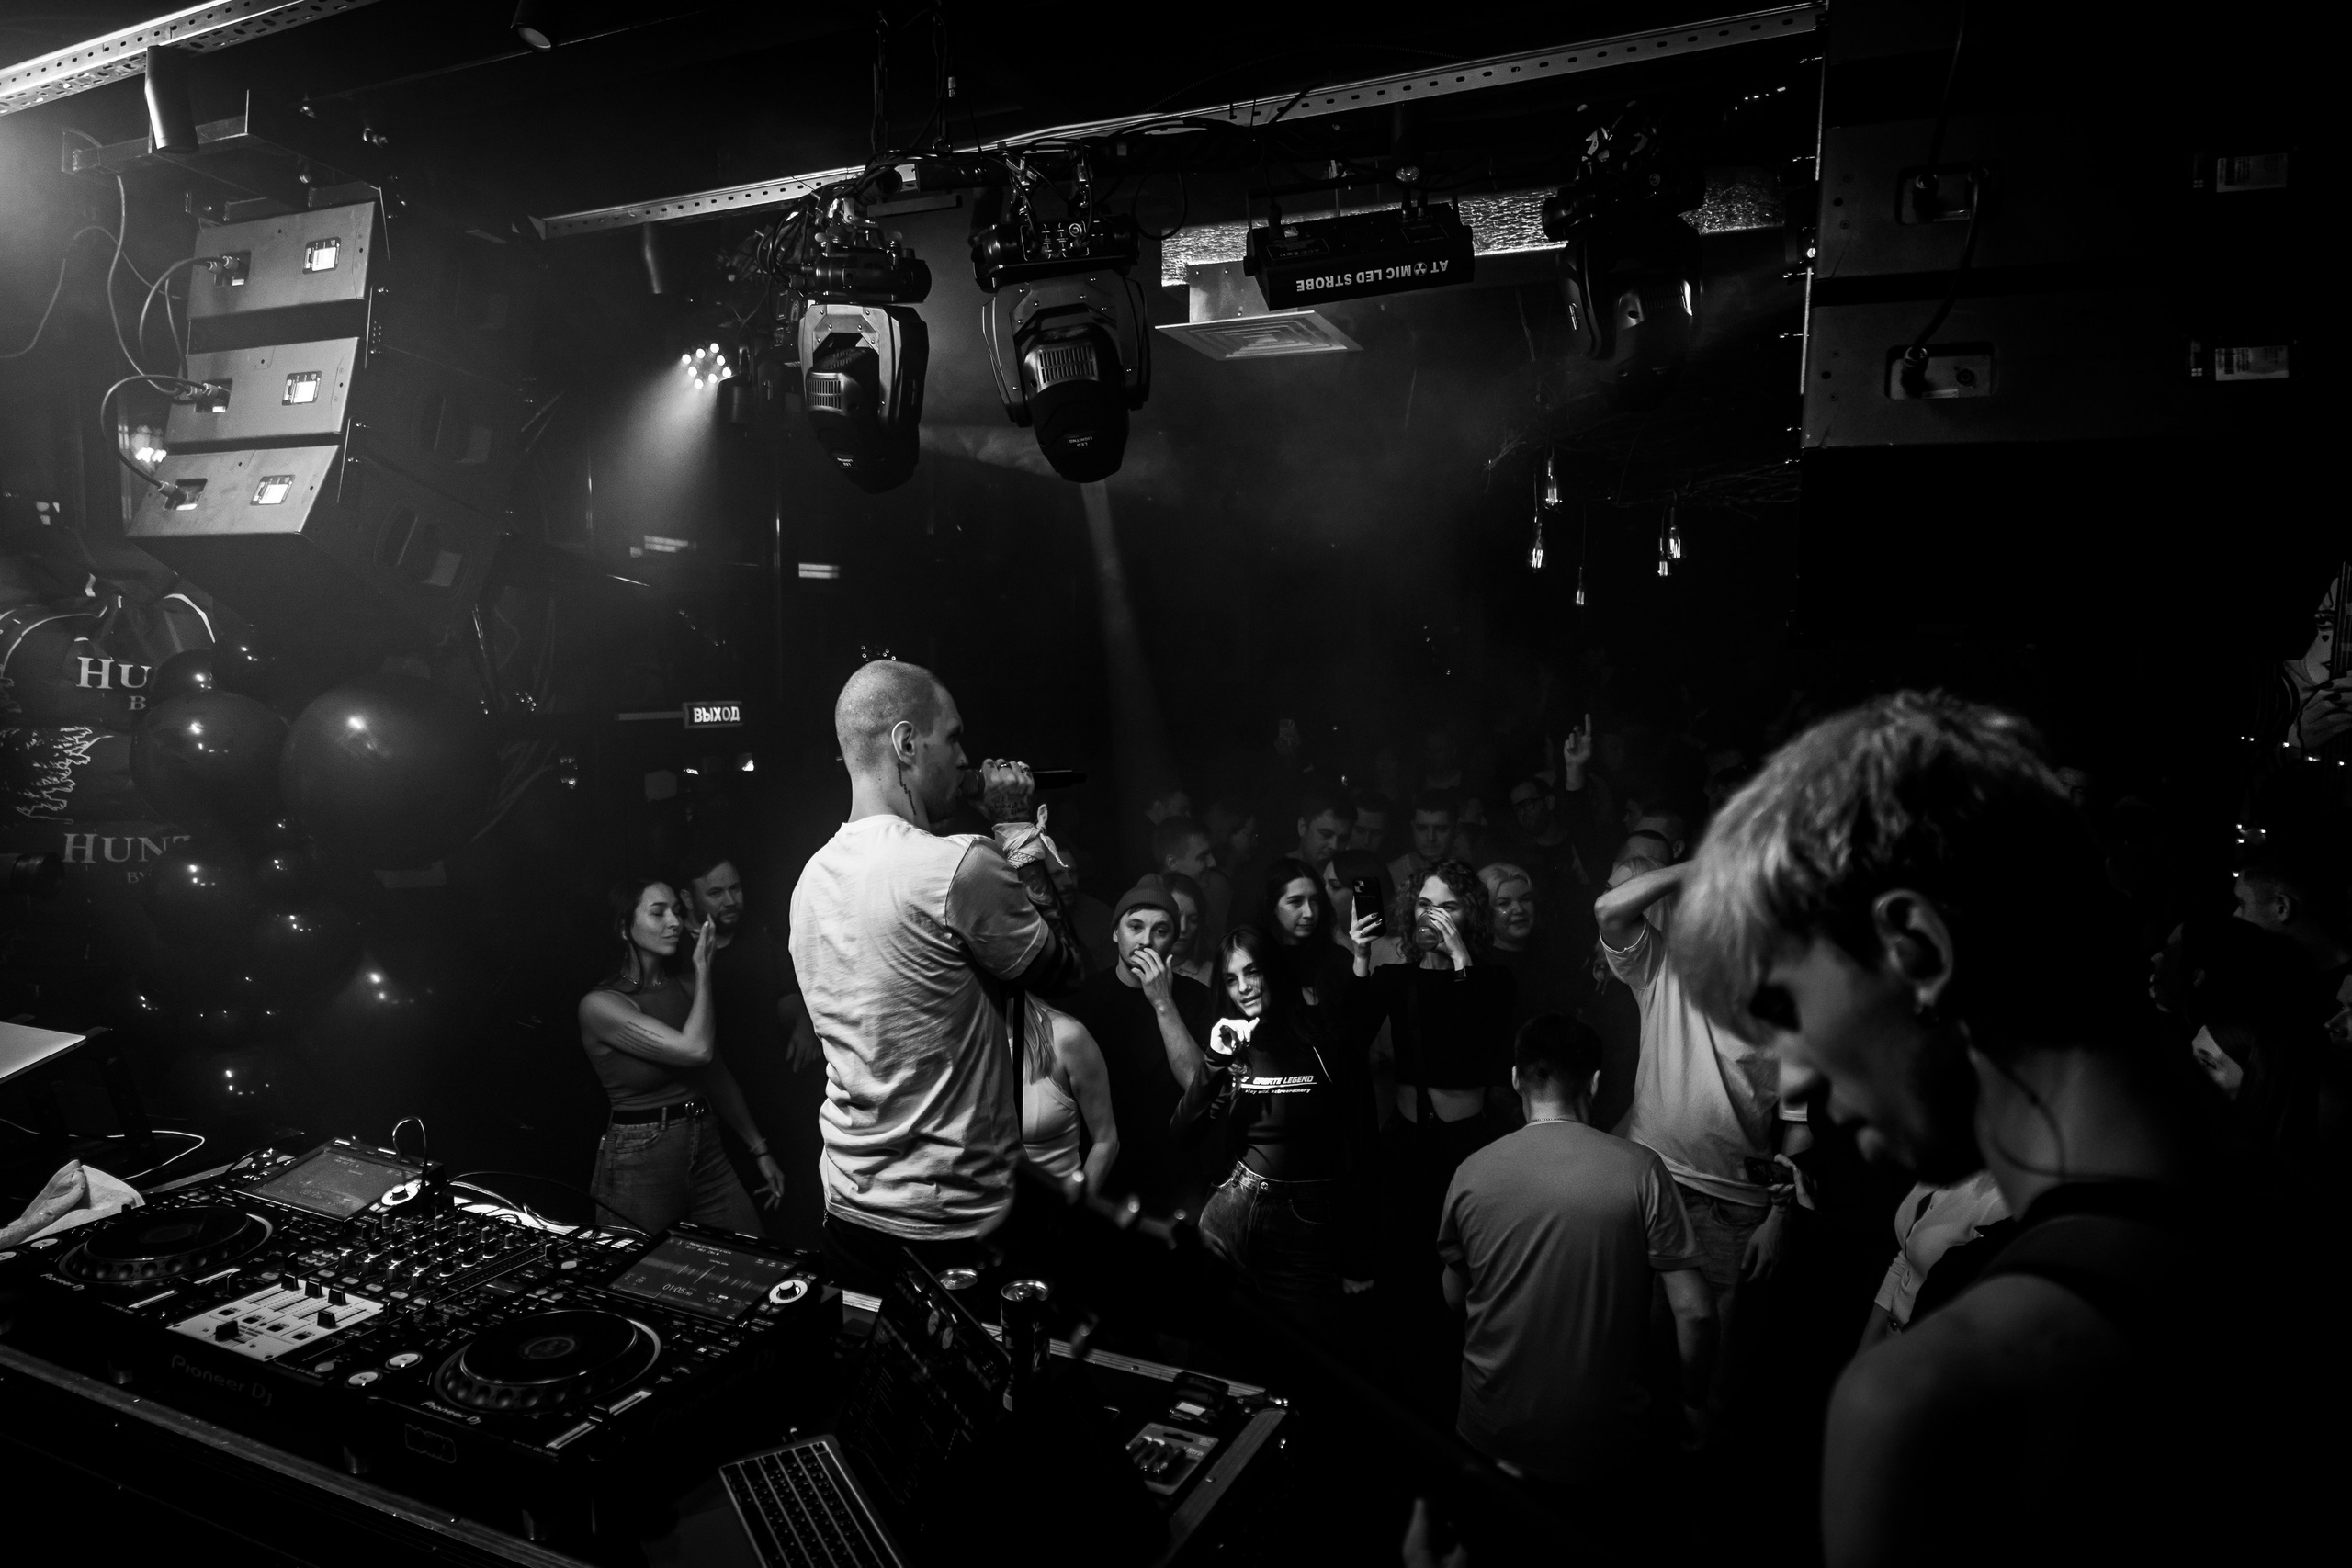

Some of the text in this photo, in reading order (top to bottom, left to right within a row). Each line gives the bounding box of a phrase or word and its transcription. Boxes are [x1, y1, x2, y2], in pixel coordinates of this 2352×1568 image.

[1295, 272, 1353, 293] STROBE
[1355, 268, 1383, 284] LED
[76, 656, 152, 690] HU
[693, 706, 741, 723] ВЫХОД
[1283, 1075, 1315, 1084] LEGEND
[170, 1353, 248, 1393] Pioneer
